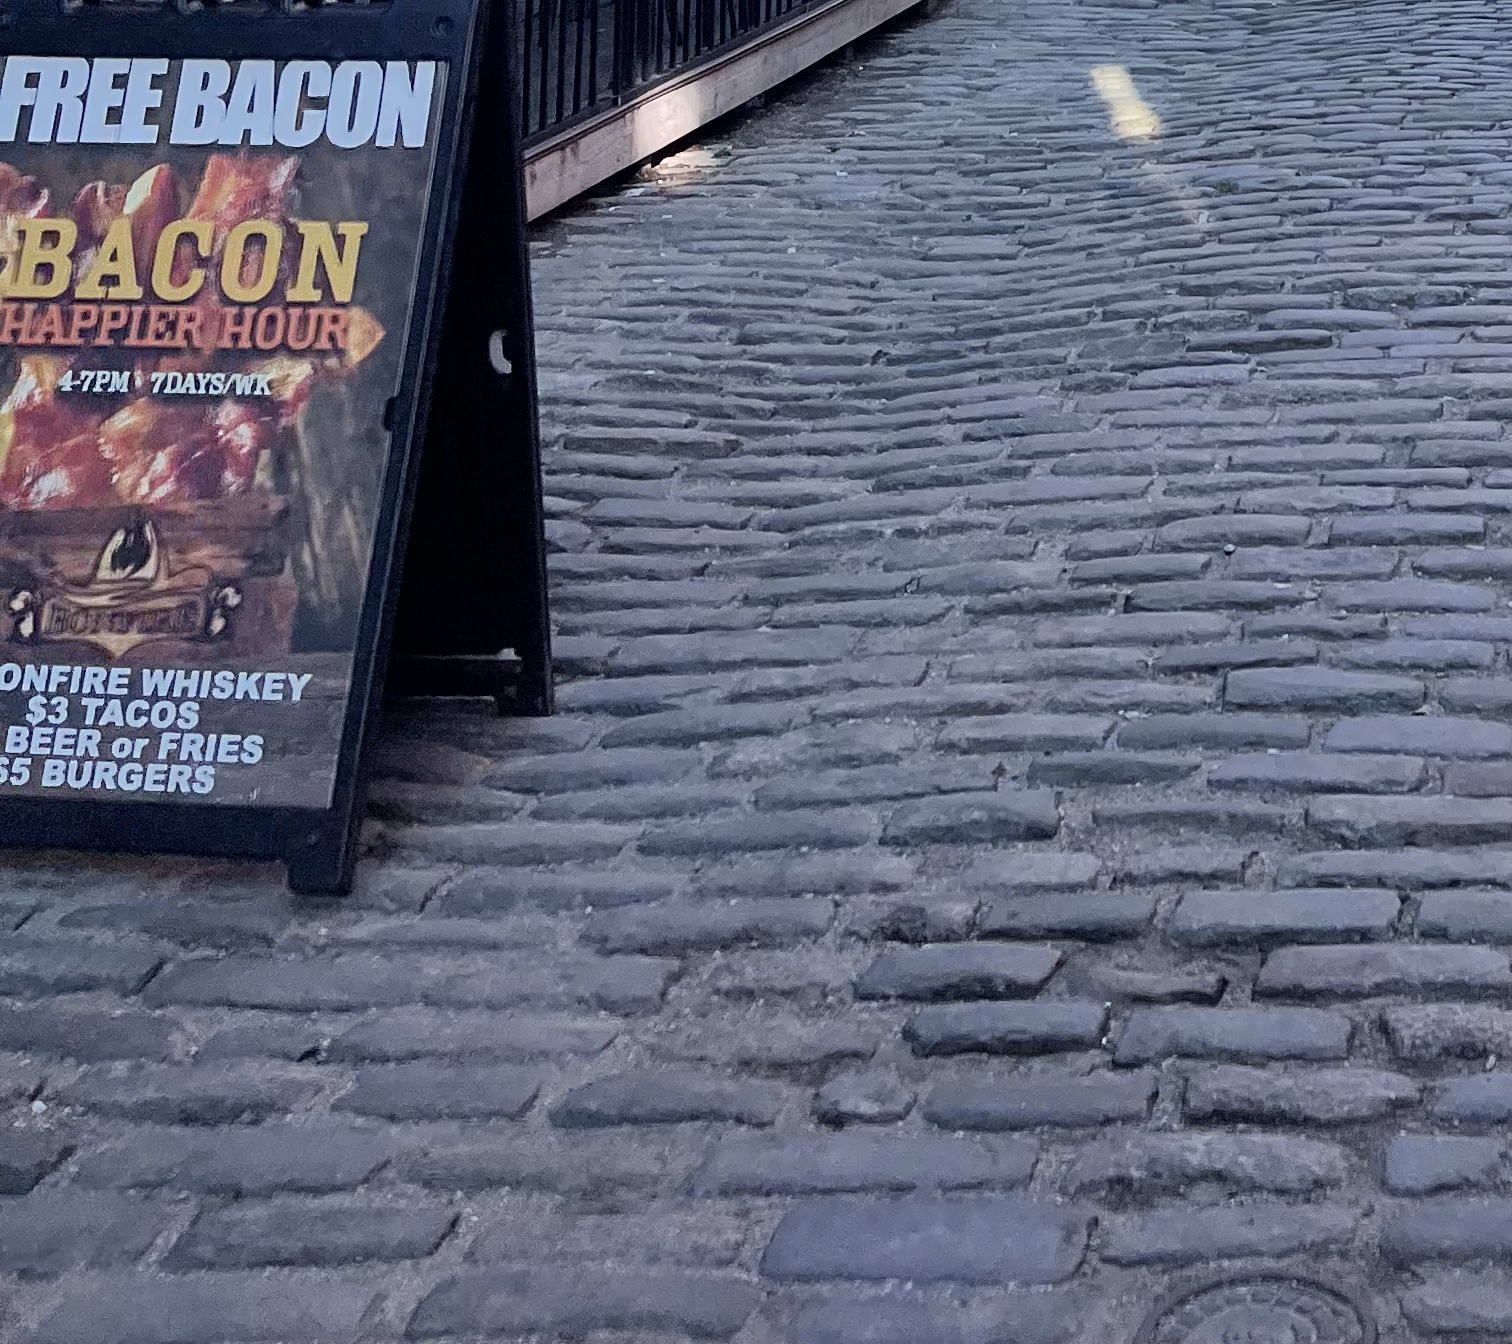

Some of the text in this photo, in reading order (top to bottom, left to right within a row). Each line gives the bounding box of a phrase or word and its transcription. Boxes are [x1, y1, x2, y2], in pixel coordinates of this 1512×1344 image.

[0, 55, 436, 149] FREE BACON
[3, 217, 369, 303] BACON
[0, 303, 347, 350] HAPPIER HOUR
[58, 369, 272, 396] 4-7PM 7DAYS/WK
[142, 668, 313, 702] WHISKEY
[26, 694, 200, 730] $3 TACOS
[4, 725, 264, 764] BEER or FRIES
[41, 759, 216, 795] BURGERS
